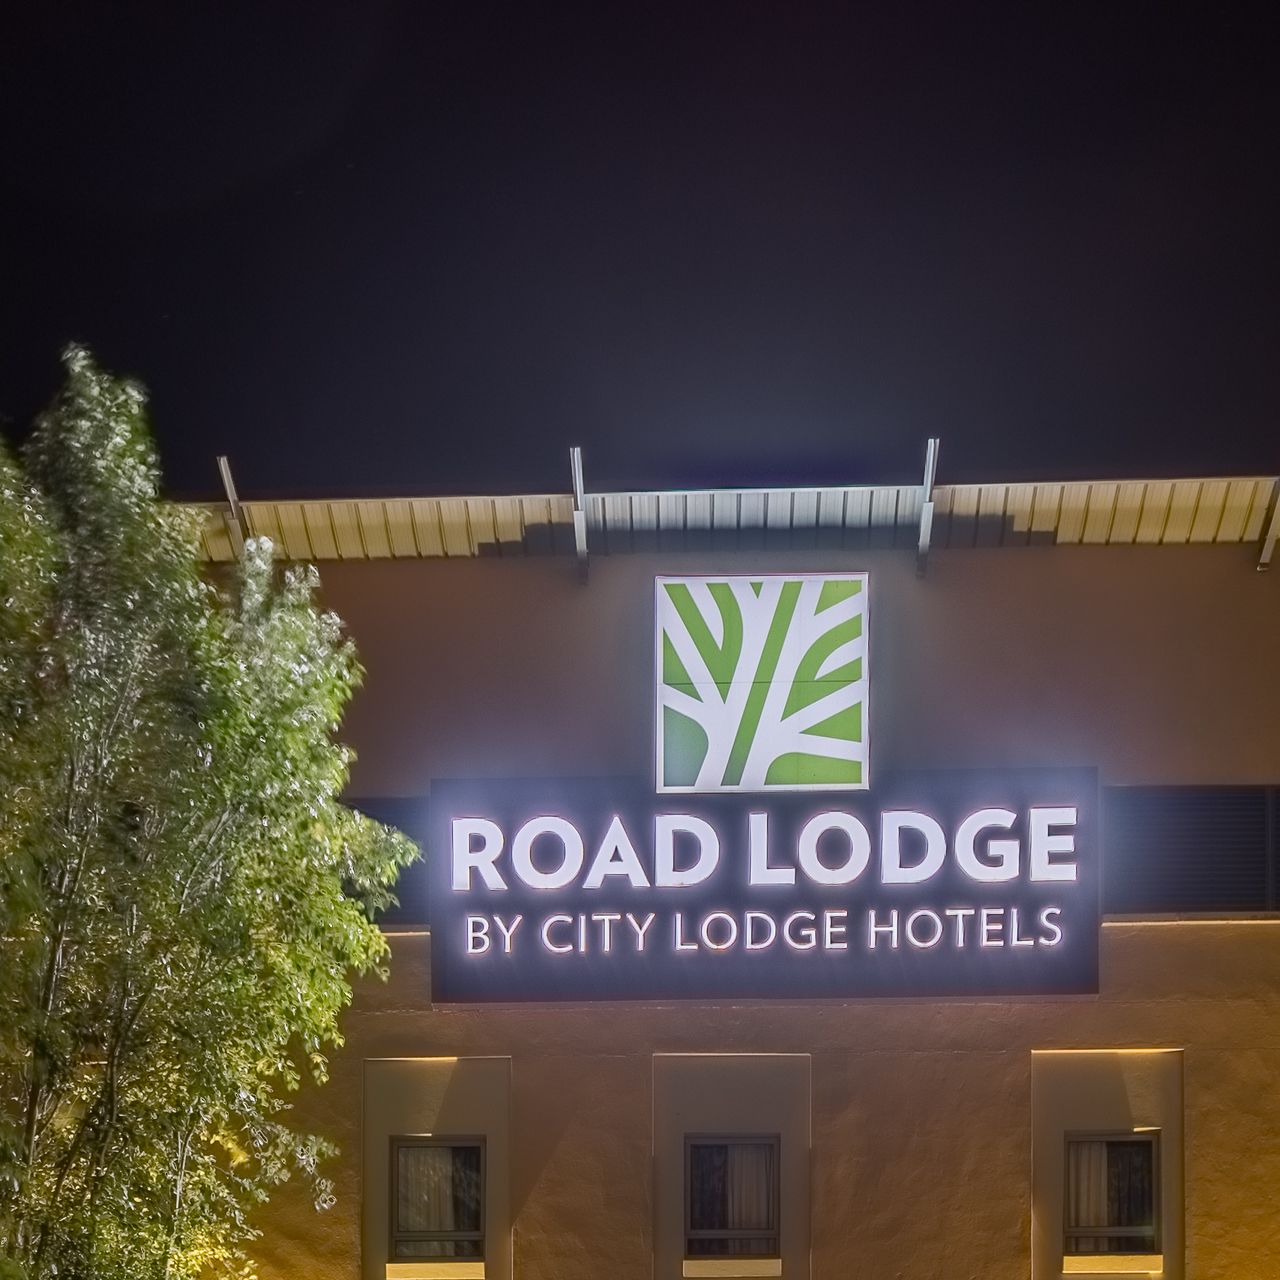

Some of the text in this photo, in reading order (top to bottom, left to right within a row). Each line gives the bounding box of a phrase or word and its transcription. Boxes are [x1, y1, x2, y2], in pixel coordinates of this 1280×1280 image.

[451, 807, 1077, 891] ROAD LODGE
[466, 907, 1063, 954] BY CITY LODGE HOTELS
